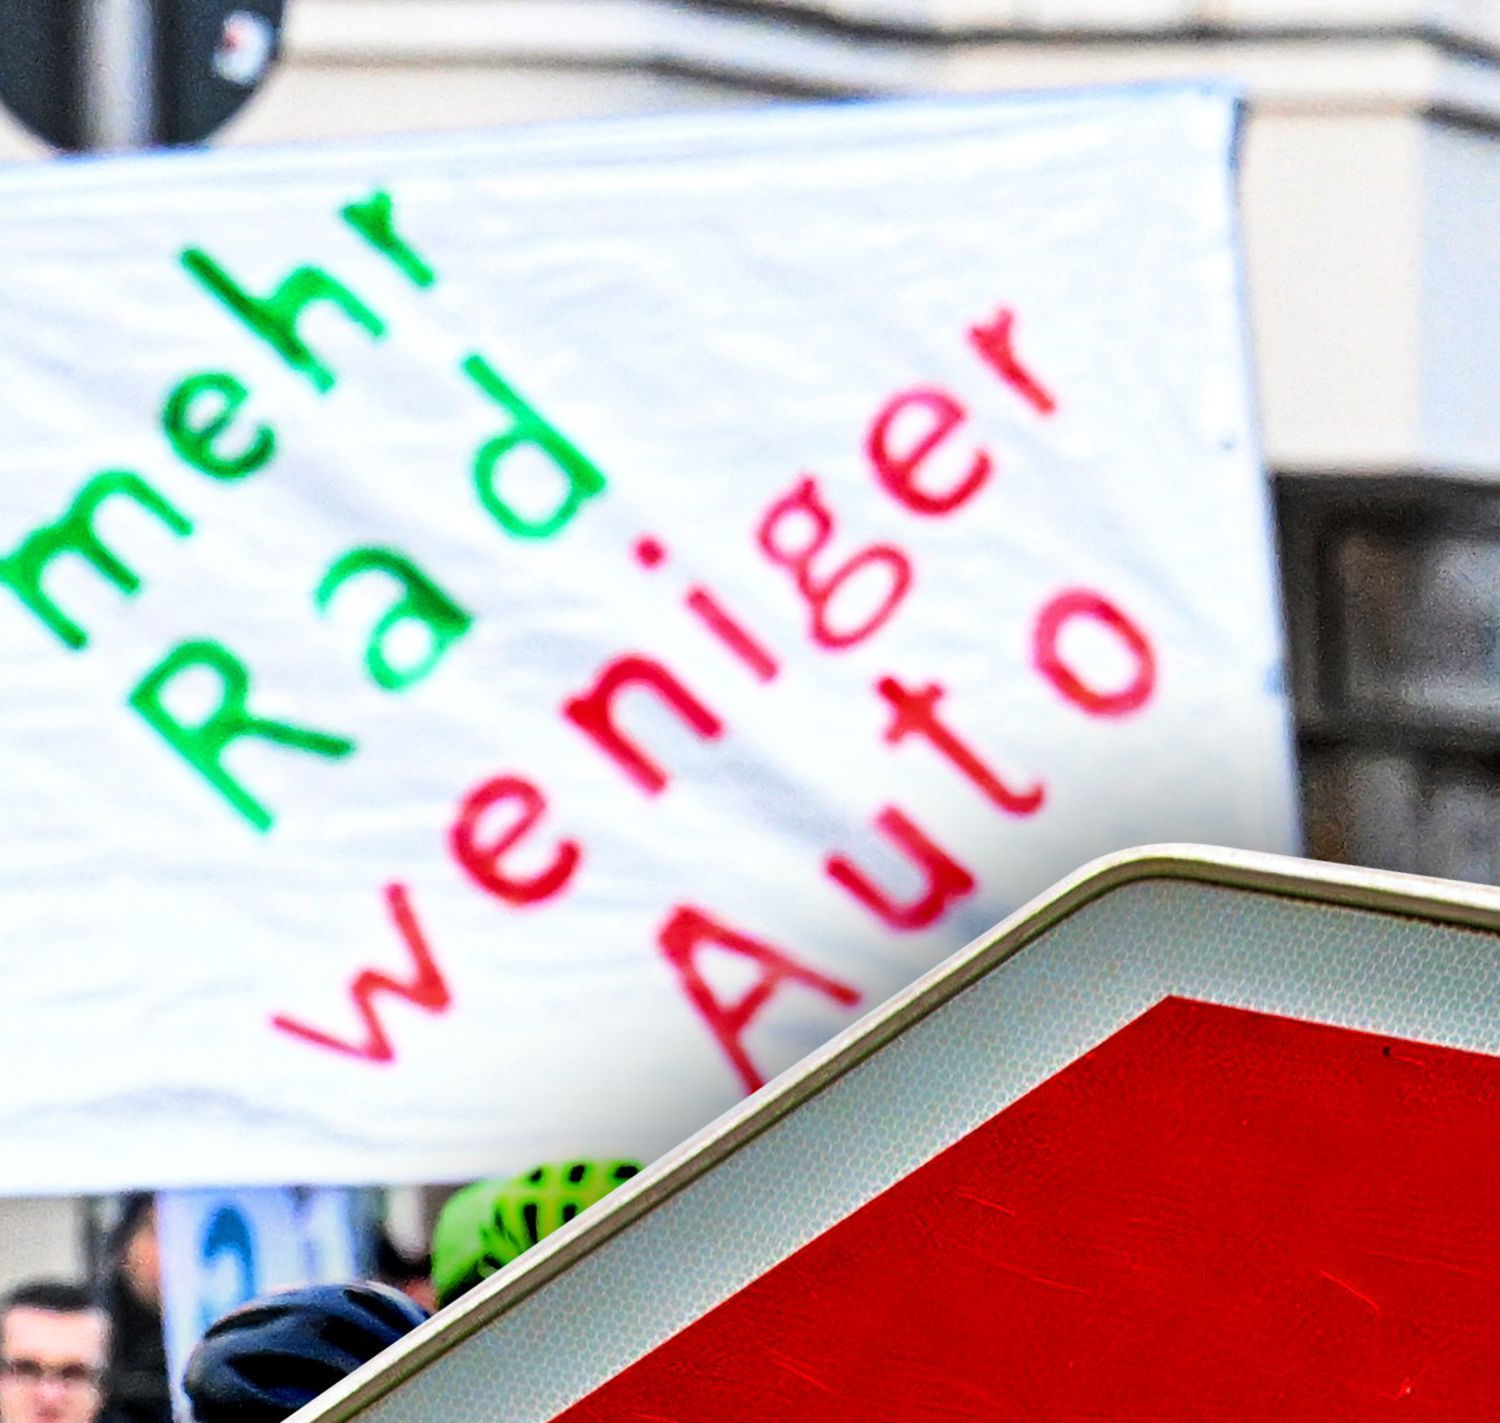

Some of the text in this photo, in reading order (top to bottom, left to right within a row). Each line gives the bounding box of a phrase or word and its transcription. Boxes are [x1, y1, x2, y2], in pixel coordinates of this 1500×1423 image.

[125, 350, 606, 834] Rad
[271, 304, 1059, 1065] weniger
[656, 588, 1160, 1094] Auto
